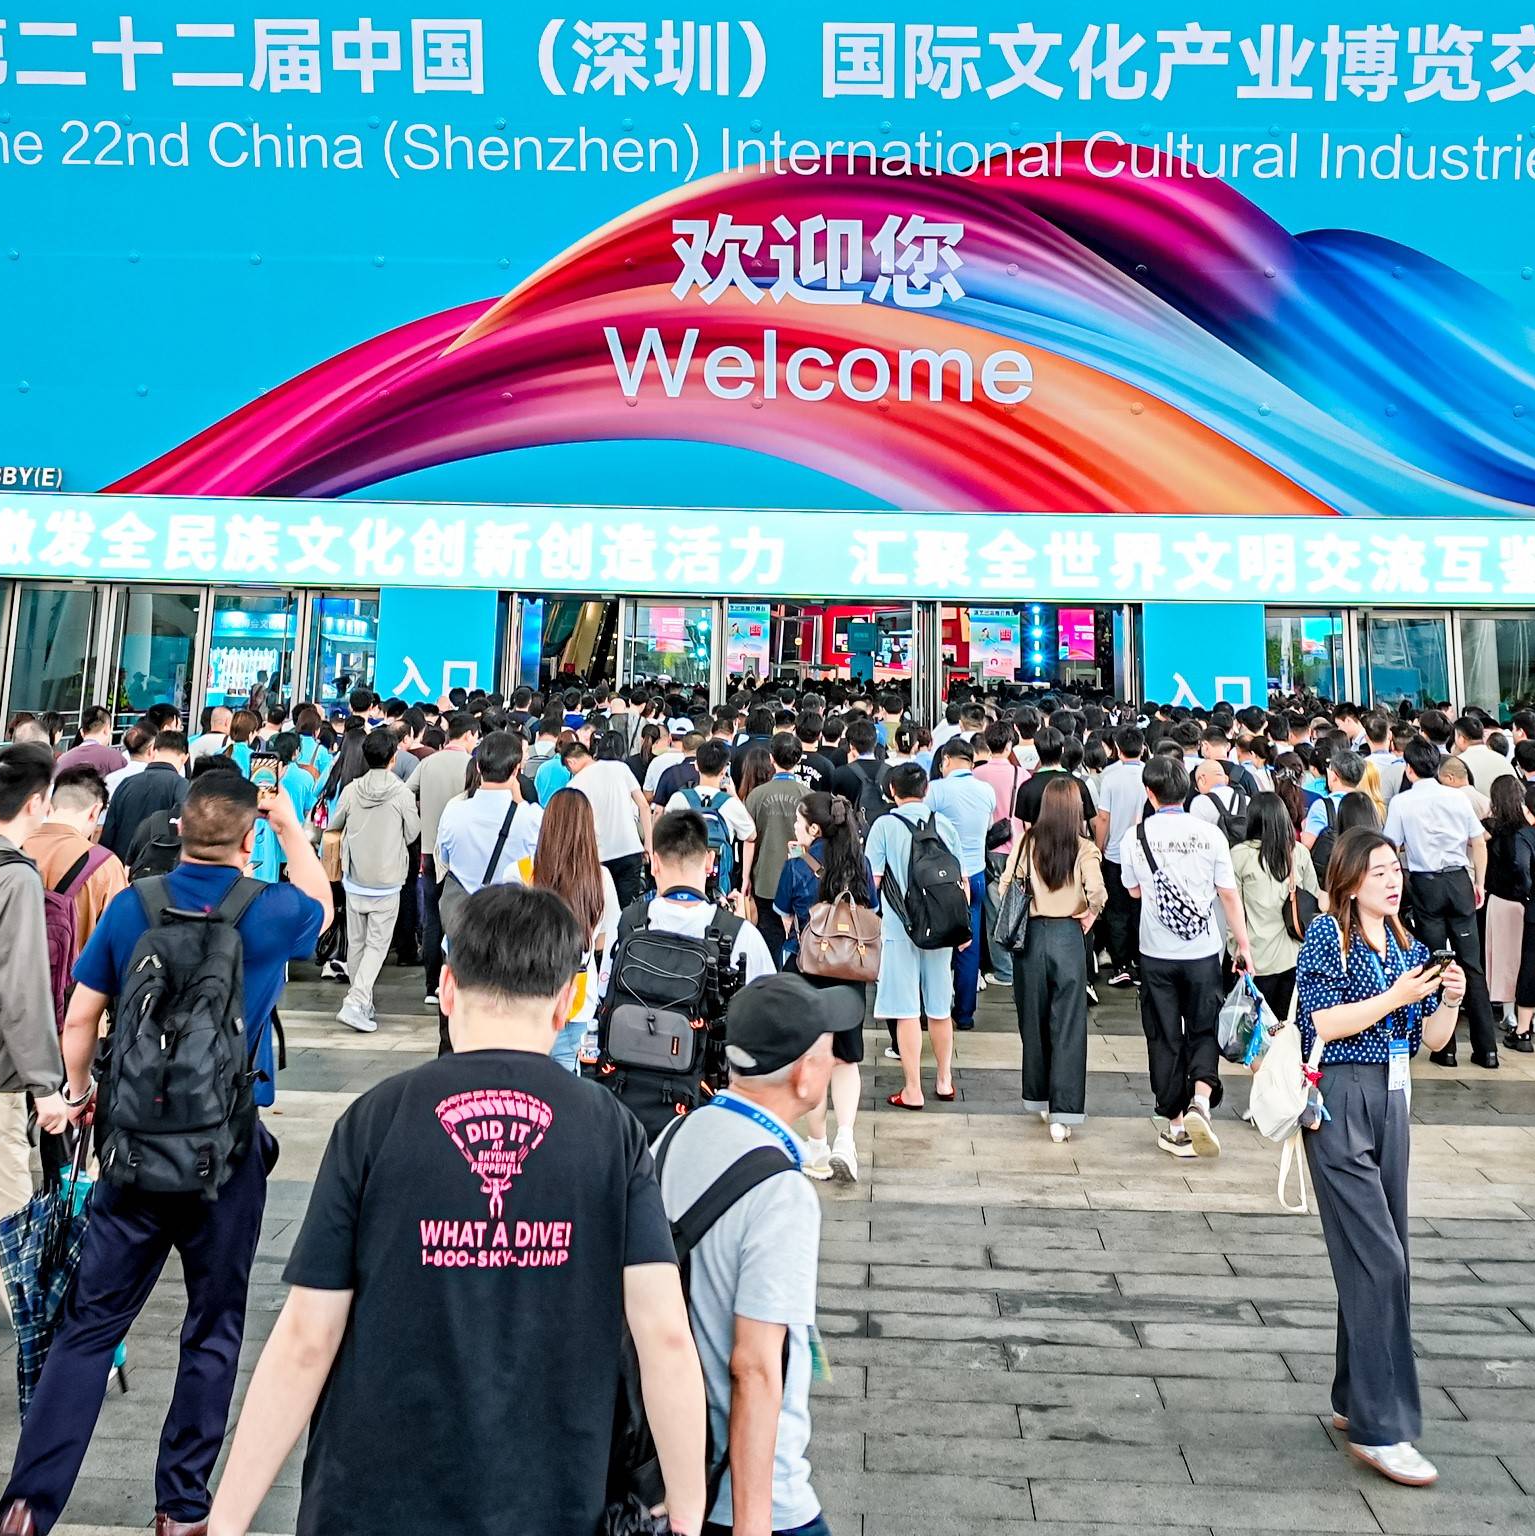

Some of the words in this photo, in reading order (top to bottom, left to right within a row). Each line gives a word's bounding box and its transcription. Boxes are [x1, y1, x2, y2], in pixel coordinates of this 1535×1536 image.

[60, 119, 190, 167] 22nd
[208, 120, 364, 170] China
[384, 122, 701, 182] (Shenzhen)
[720, 127, 1064, 177] International
[1083, 130, 1298, 180] Cultural
[670, 213, 966, 308] 欢迎您
[603, 326, 1035, 404] Welcome
[392, 655, 478, 701] 入口
[1170, 672, 1251, 714] 入口
[465, 1120, 504, 1144] DID
[509, 1121, 531, 1144] IT
[492, 1139, 504, 1151] AT
[470, 1162, 523, 1175] PEPPERELL
[477, 1150, 517, 1163] SKYDIVE
[419, 1219, 488, 1248] WHAT
[491, 1221, 509, 1248] A
[515, 1220, 572, 1248] DIVE!
[421, 1248, 569, 1268] 1-800-SKY-JUMP
